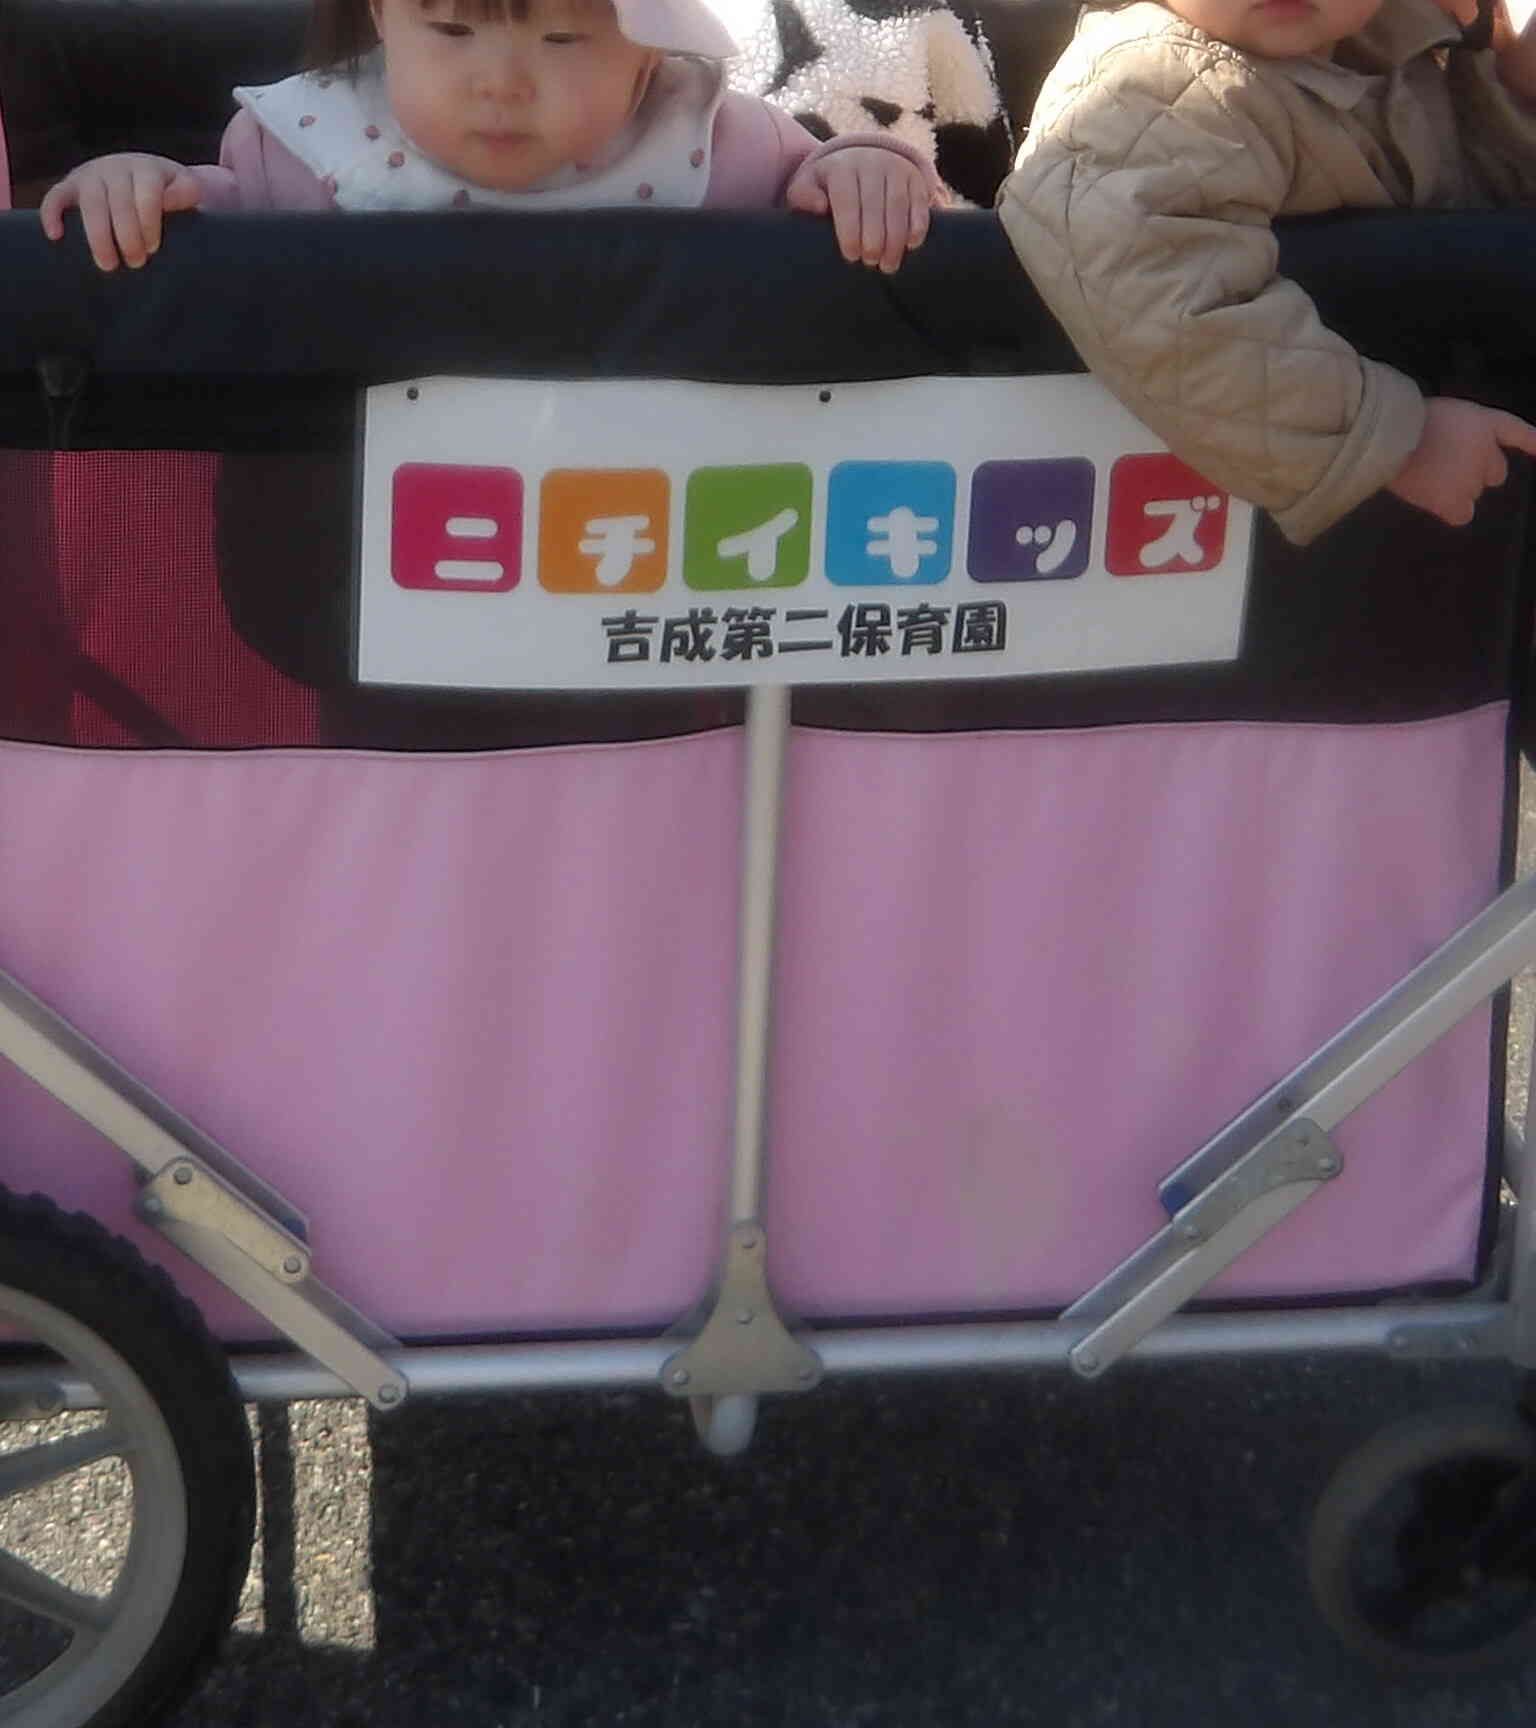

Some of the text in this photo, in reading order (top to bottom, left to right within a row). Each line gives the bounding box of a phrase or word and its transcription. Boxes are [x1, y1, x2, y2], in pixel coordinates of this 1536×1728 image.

[433, 494, 1221, 587] ニチイキッズ
[600, 600, 1007, 664] 吉成第二保育園
